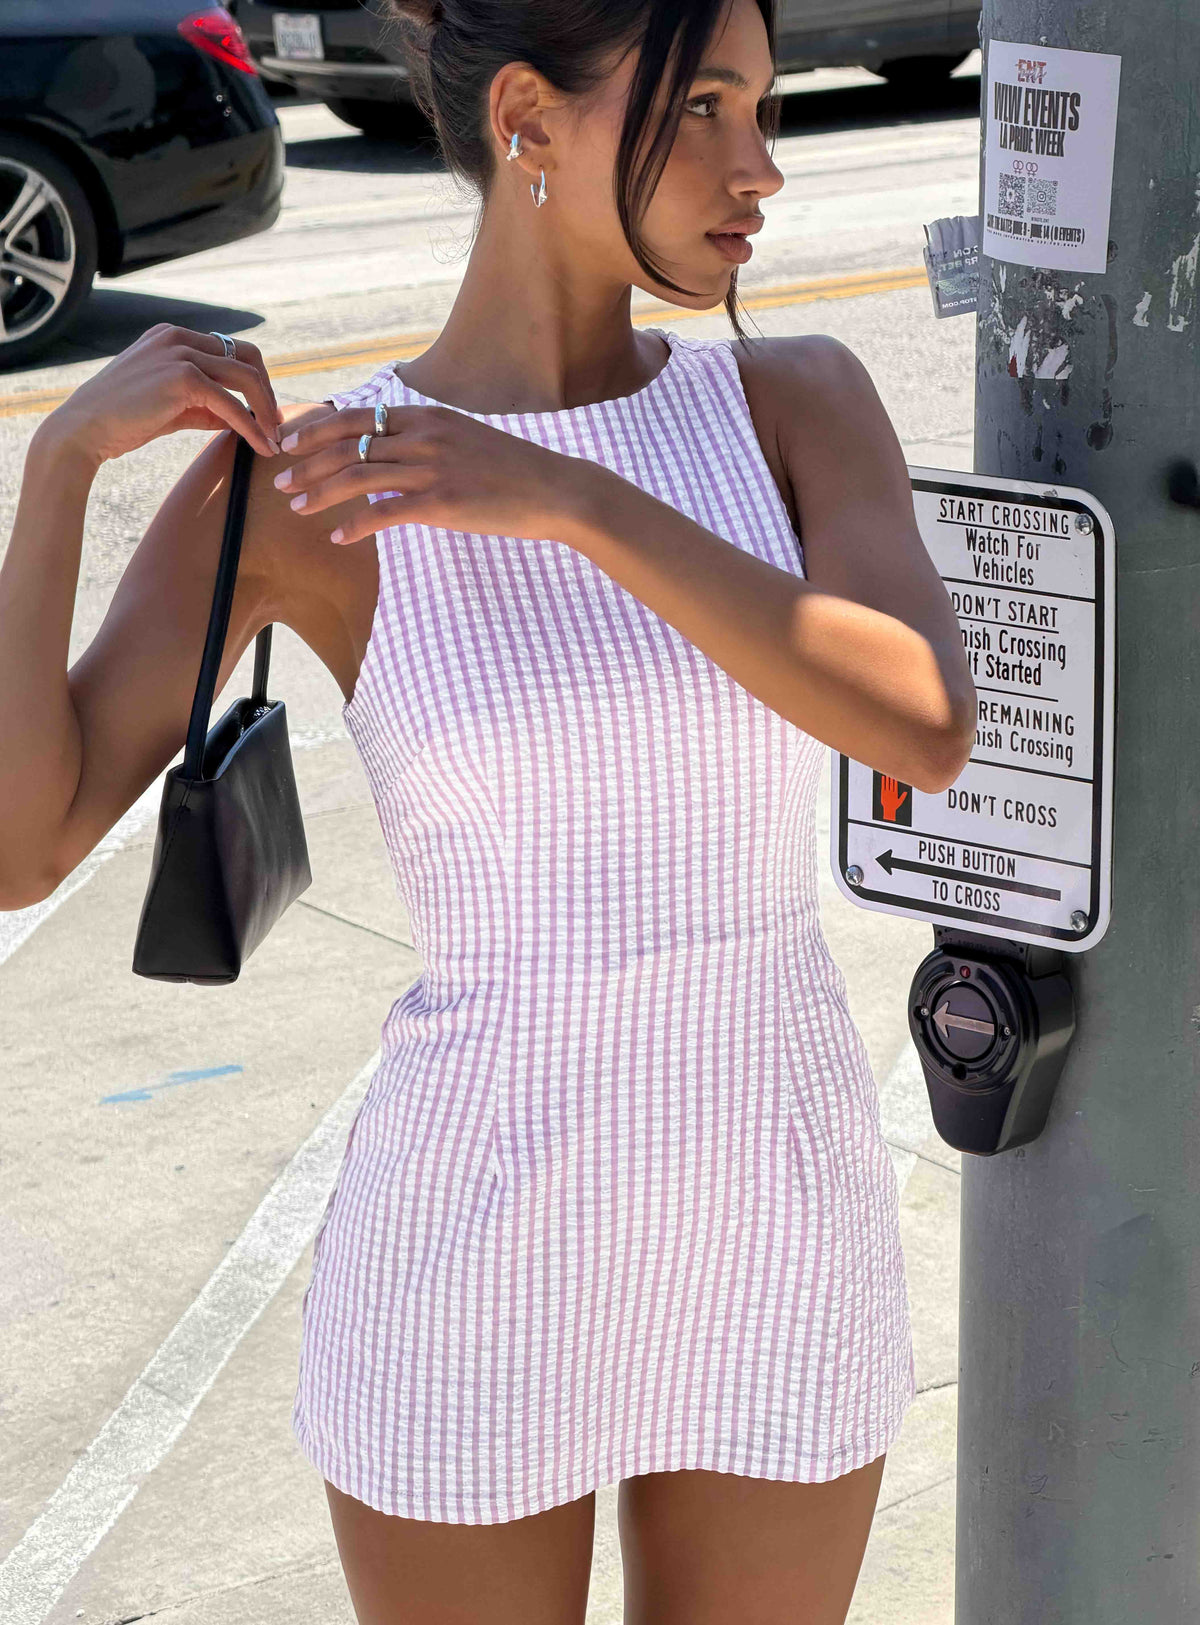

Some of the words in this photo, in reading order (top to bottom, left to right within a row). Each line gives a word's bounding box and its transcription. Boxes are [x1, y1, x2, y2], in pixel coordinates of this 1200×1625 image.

[994, 82, 1022, 124] WLW
[1024, 88, 1081, 131] EVENTS
[1000, 122, 1008, 150] LA
[1008, 124, 1034, 154] PRIDE
[1036, 128, 1066, 157] WEEK
[940, 498, 984, 523] START
[992, 505, 1069, 535] CROSSING
[966, 528, 1009, 557] Watch
[1017, 535, 1041, 560] For
[973, 554, 1034, 586] Vehicles
[952, 592, 1000, 618] DON'T
[1008, 601, 1058, 628] START
[999, 629, 1066, 670] Crossing
[986, 654, 1041, 686] Started
[979, 700, 1074, 736] REMAINING
[1010, 731, 1073, 768] Crossing
[948, 788, 996, 817] DON'T
[1004, 799, 1057, 828] CROSS
[918, 840, 955, 866] PUSH
[962, 849, 1016, 877] BUTTON
[932, 880, 948, 901] TO
[955, 884, 1000, 912] CROSS
